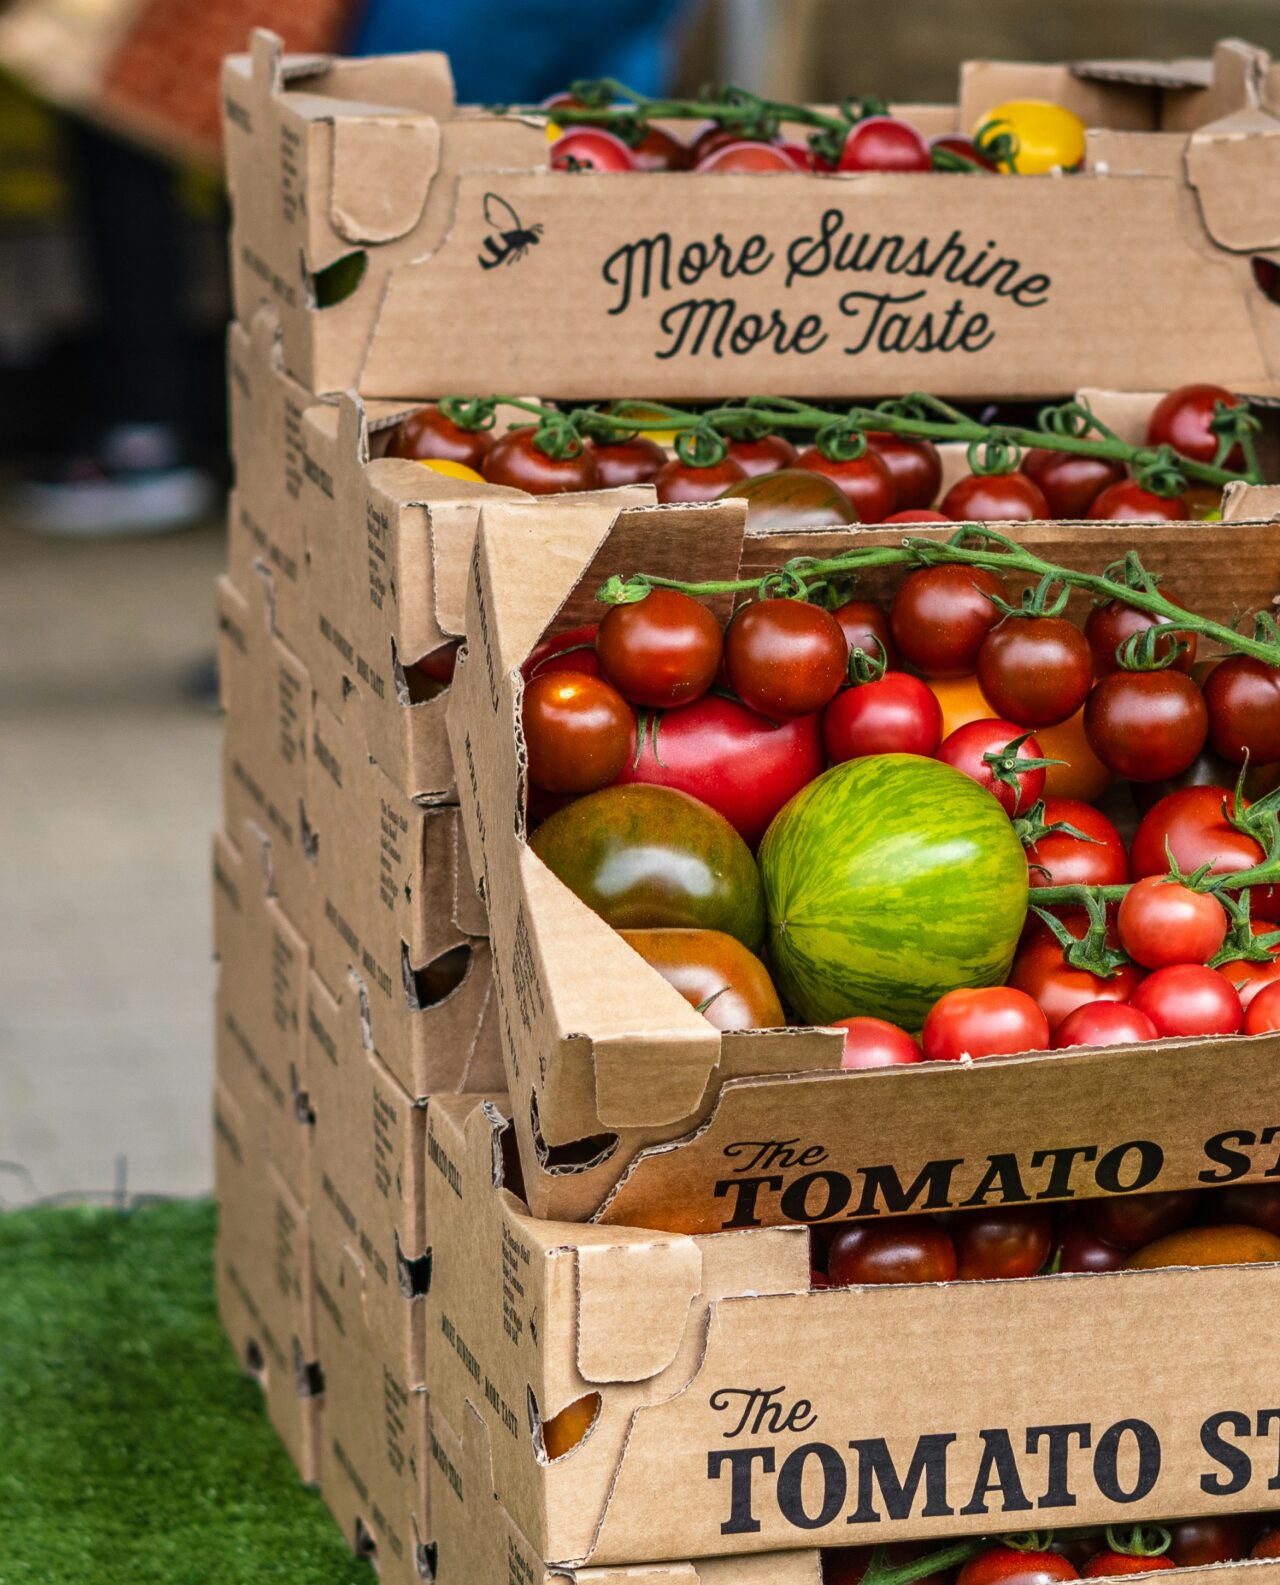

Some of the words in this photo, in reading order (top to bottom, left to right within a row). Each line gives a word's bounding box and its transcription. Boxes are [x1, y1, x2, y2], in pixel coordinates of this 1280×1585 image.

[602, 232, 774, 316] More
[785, 208, 1052, 308] Sunshine
[655, 298, 829, 360] More
[838, 289, 996, 355] Taste
[713, 1140, 1164, 1229] TOMATO
[723, 1138, 829, 1173] The
[709, 1385, 818, 1438] The
[707, 1418, 1161, 1536] TOMATO
